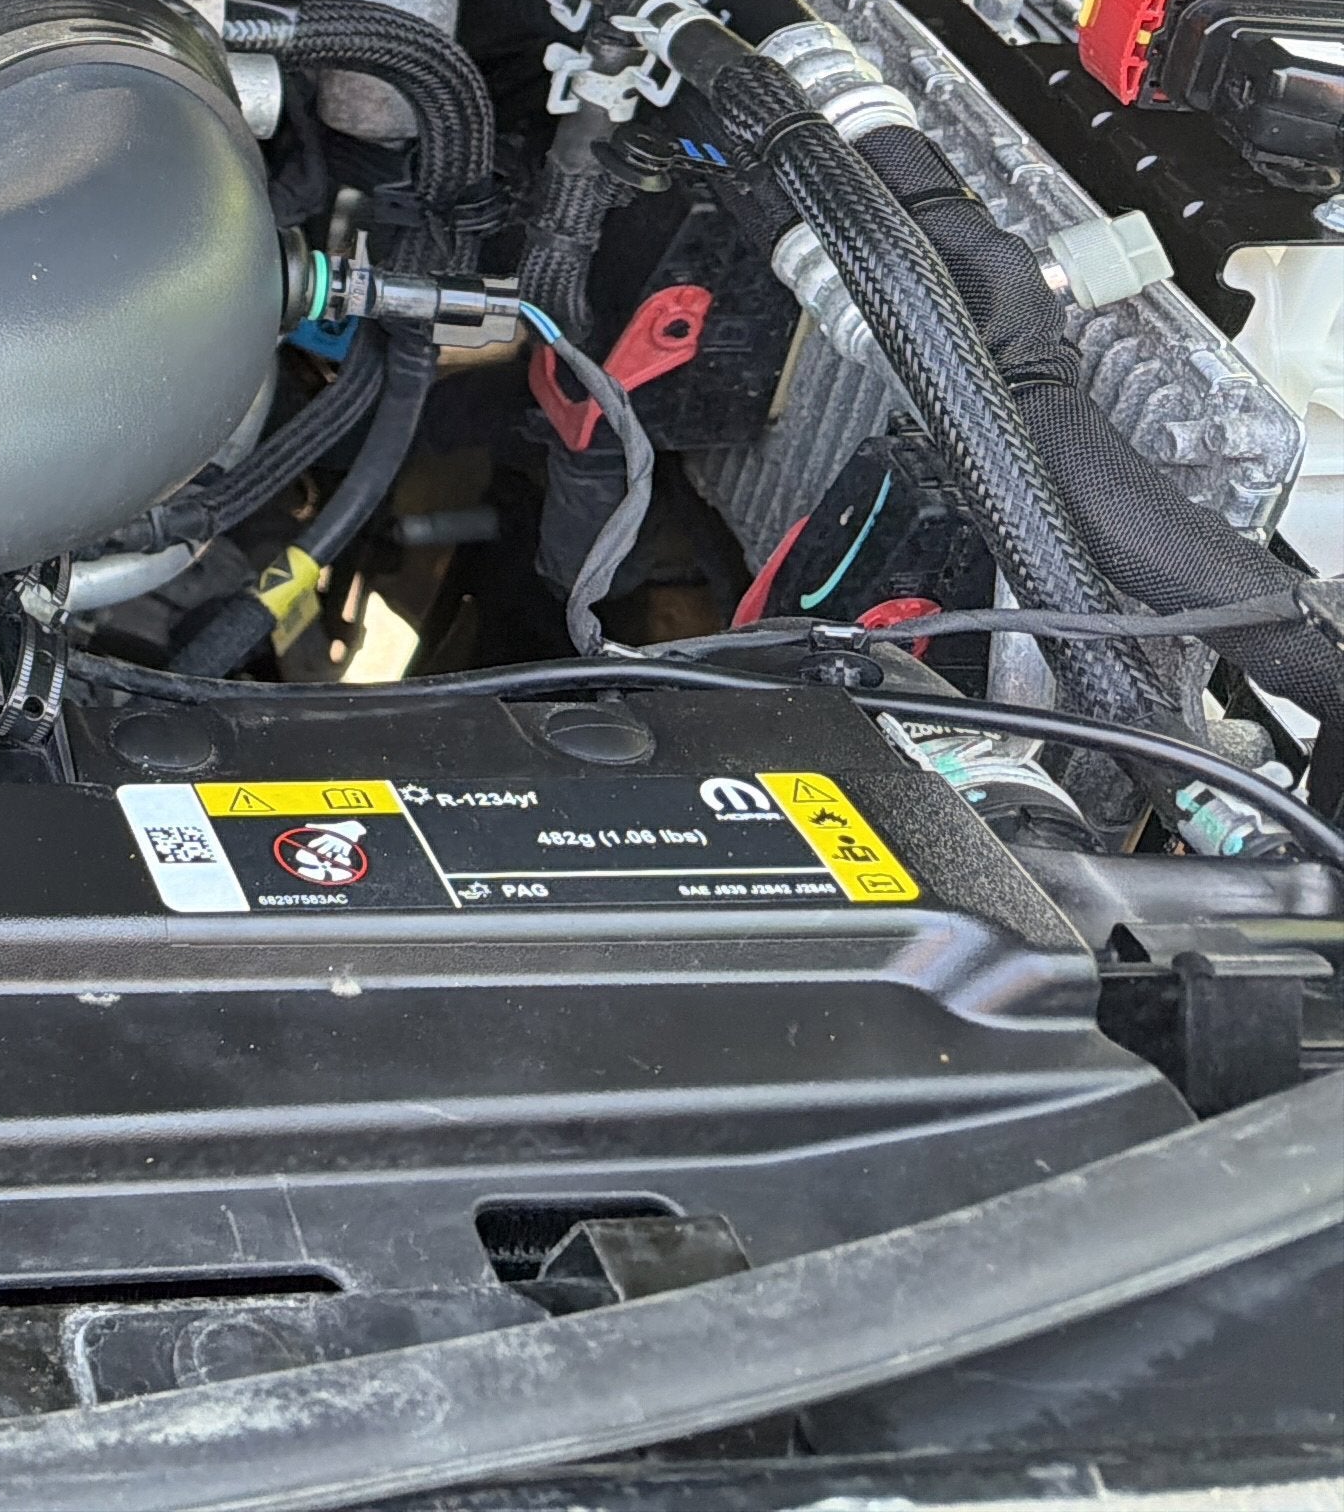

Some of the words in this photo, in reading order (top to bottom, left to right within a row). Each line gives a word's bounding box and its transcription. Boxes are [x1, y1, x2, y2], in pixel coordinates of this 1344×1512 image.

[436, 791, 538, 808] R-1234yf
[537, 831, 596, 848] 482g
[659, 828, 707, 847] lbs)
[501, 883, 550, 899] PAG
